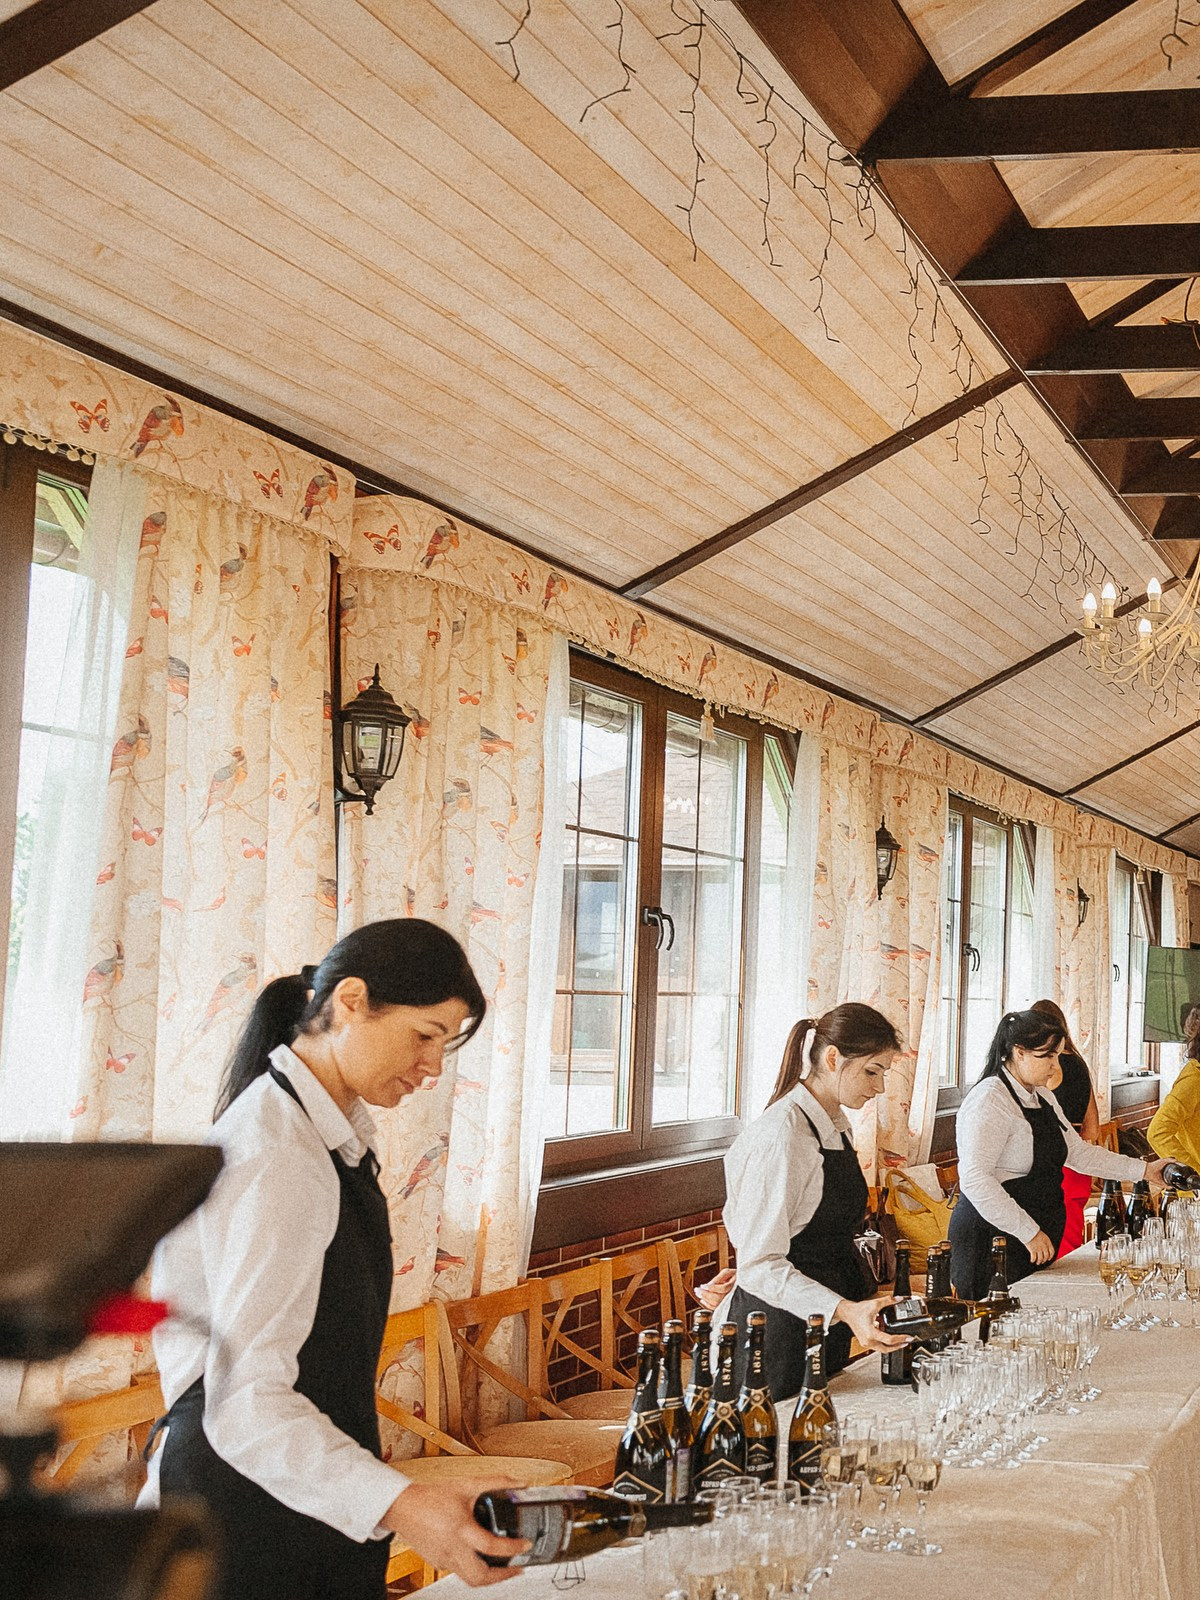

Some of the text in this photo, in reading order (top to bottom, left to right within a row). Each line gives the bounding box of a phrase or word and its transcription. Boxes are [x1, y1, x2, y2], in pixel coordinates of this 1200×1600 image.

[701, 1348, 709, 1372] 1870
[752, 1349, 762, 1374] 1870
[811, 1350, 821, 1375] 1870
